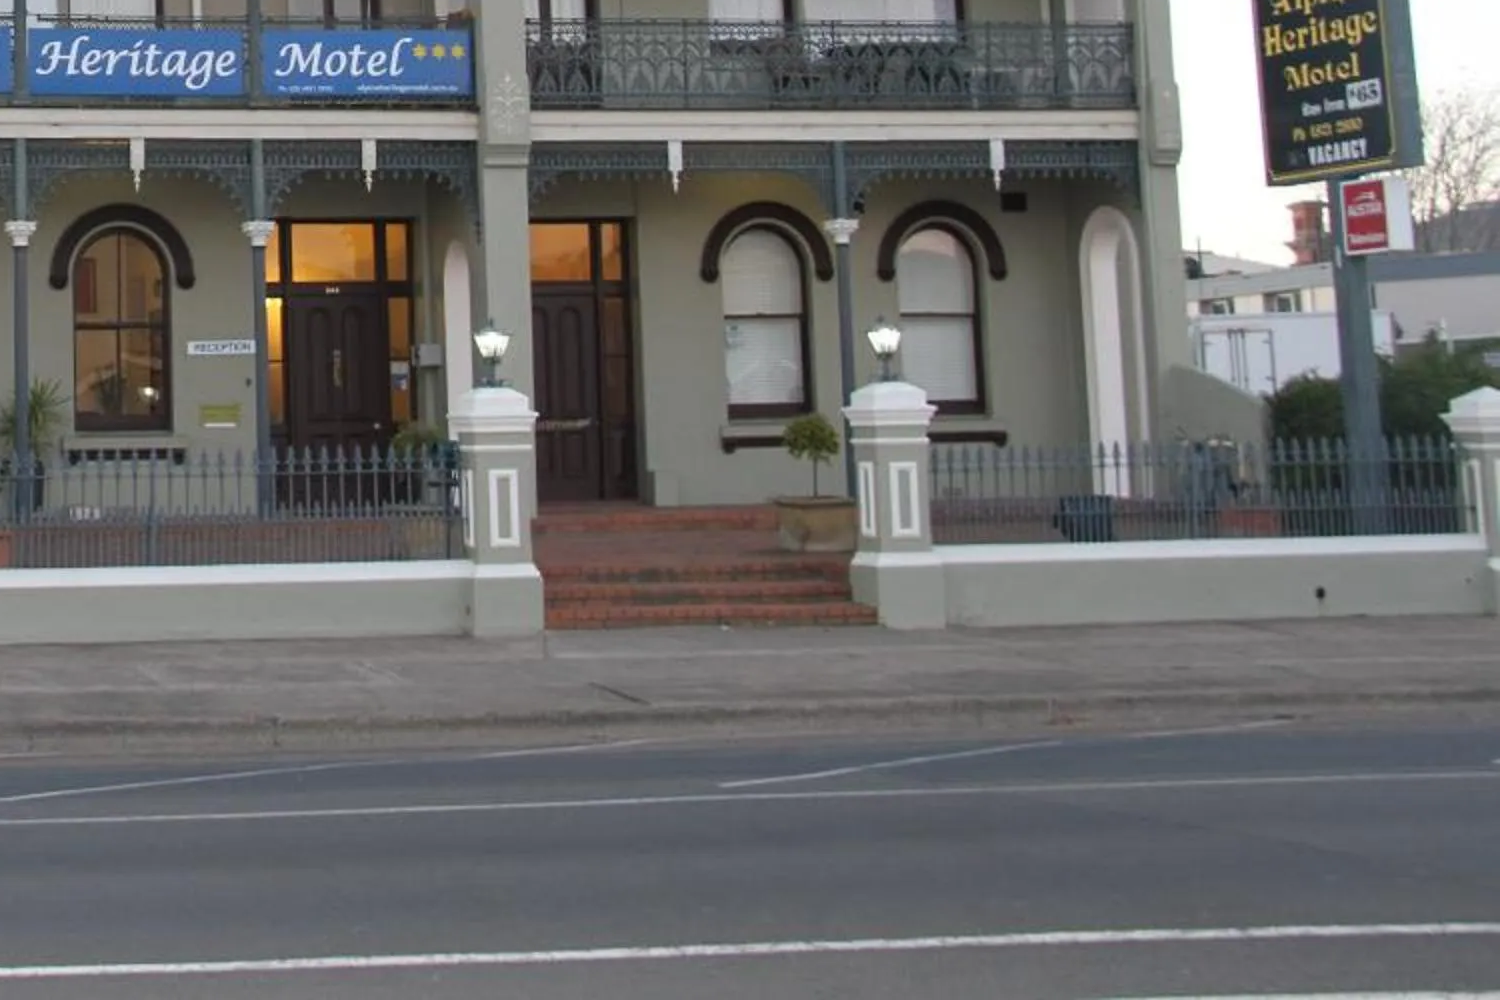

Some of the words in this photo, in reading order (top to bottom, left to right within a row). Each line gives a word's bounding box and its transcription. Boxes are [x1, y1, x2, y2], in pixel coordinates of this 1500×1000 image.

[1264, 11, 1377, 57] Heritage
[36, 35, 236, 90] Heritage
[274, 37, 413, 77] Motel
[1283, 52, 1361, 92] Motel
[1307, 138, 1367, 167] VACANCY
[193, 341, 251, 352] RECEPTION
